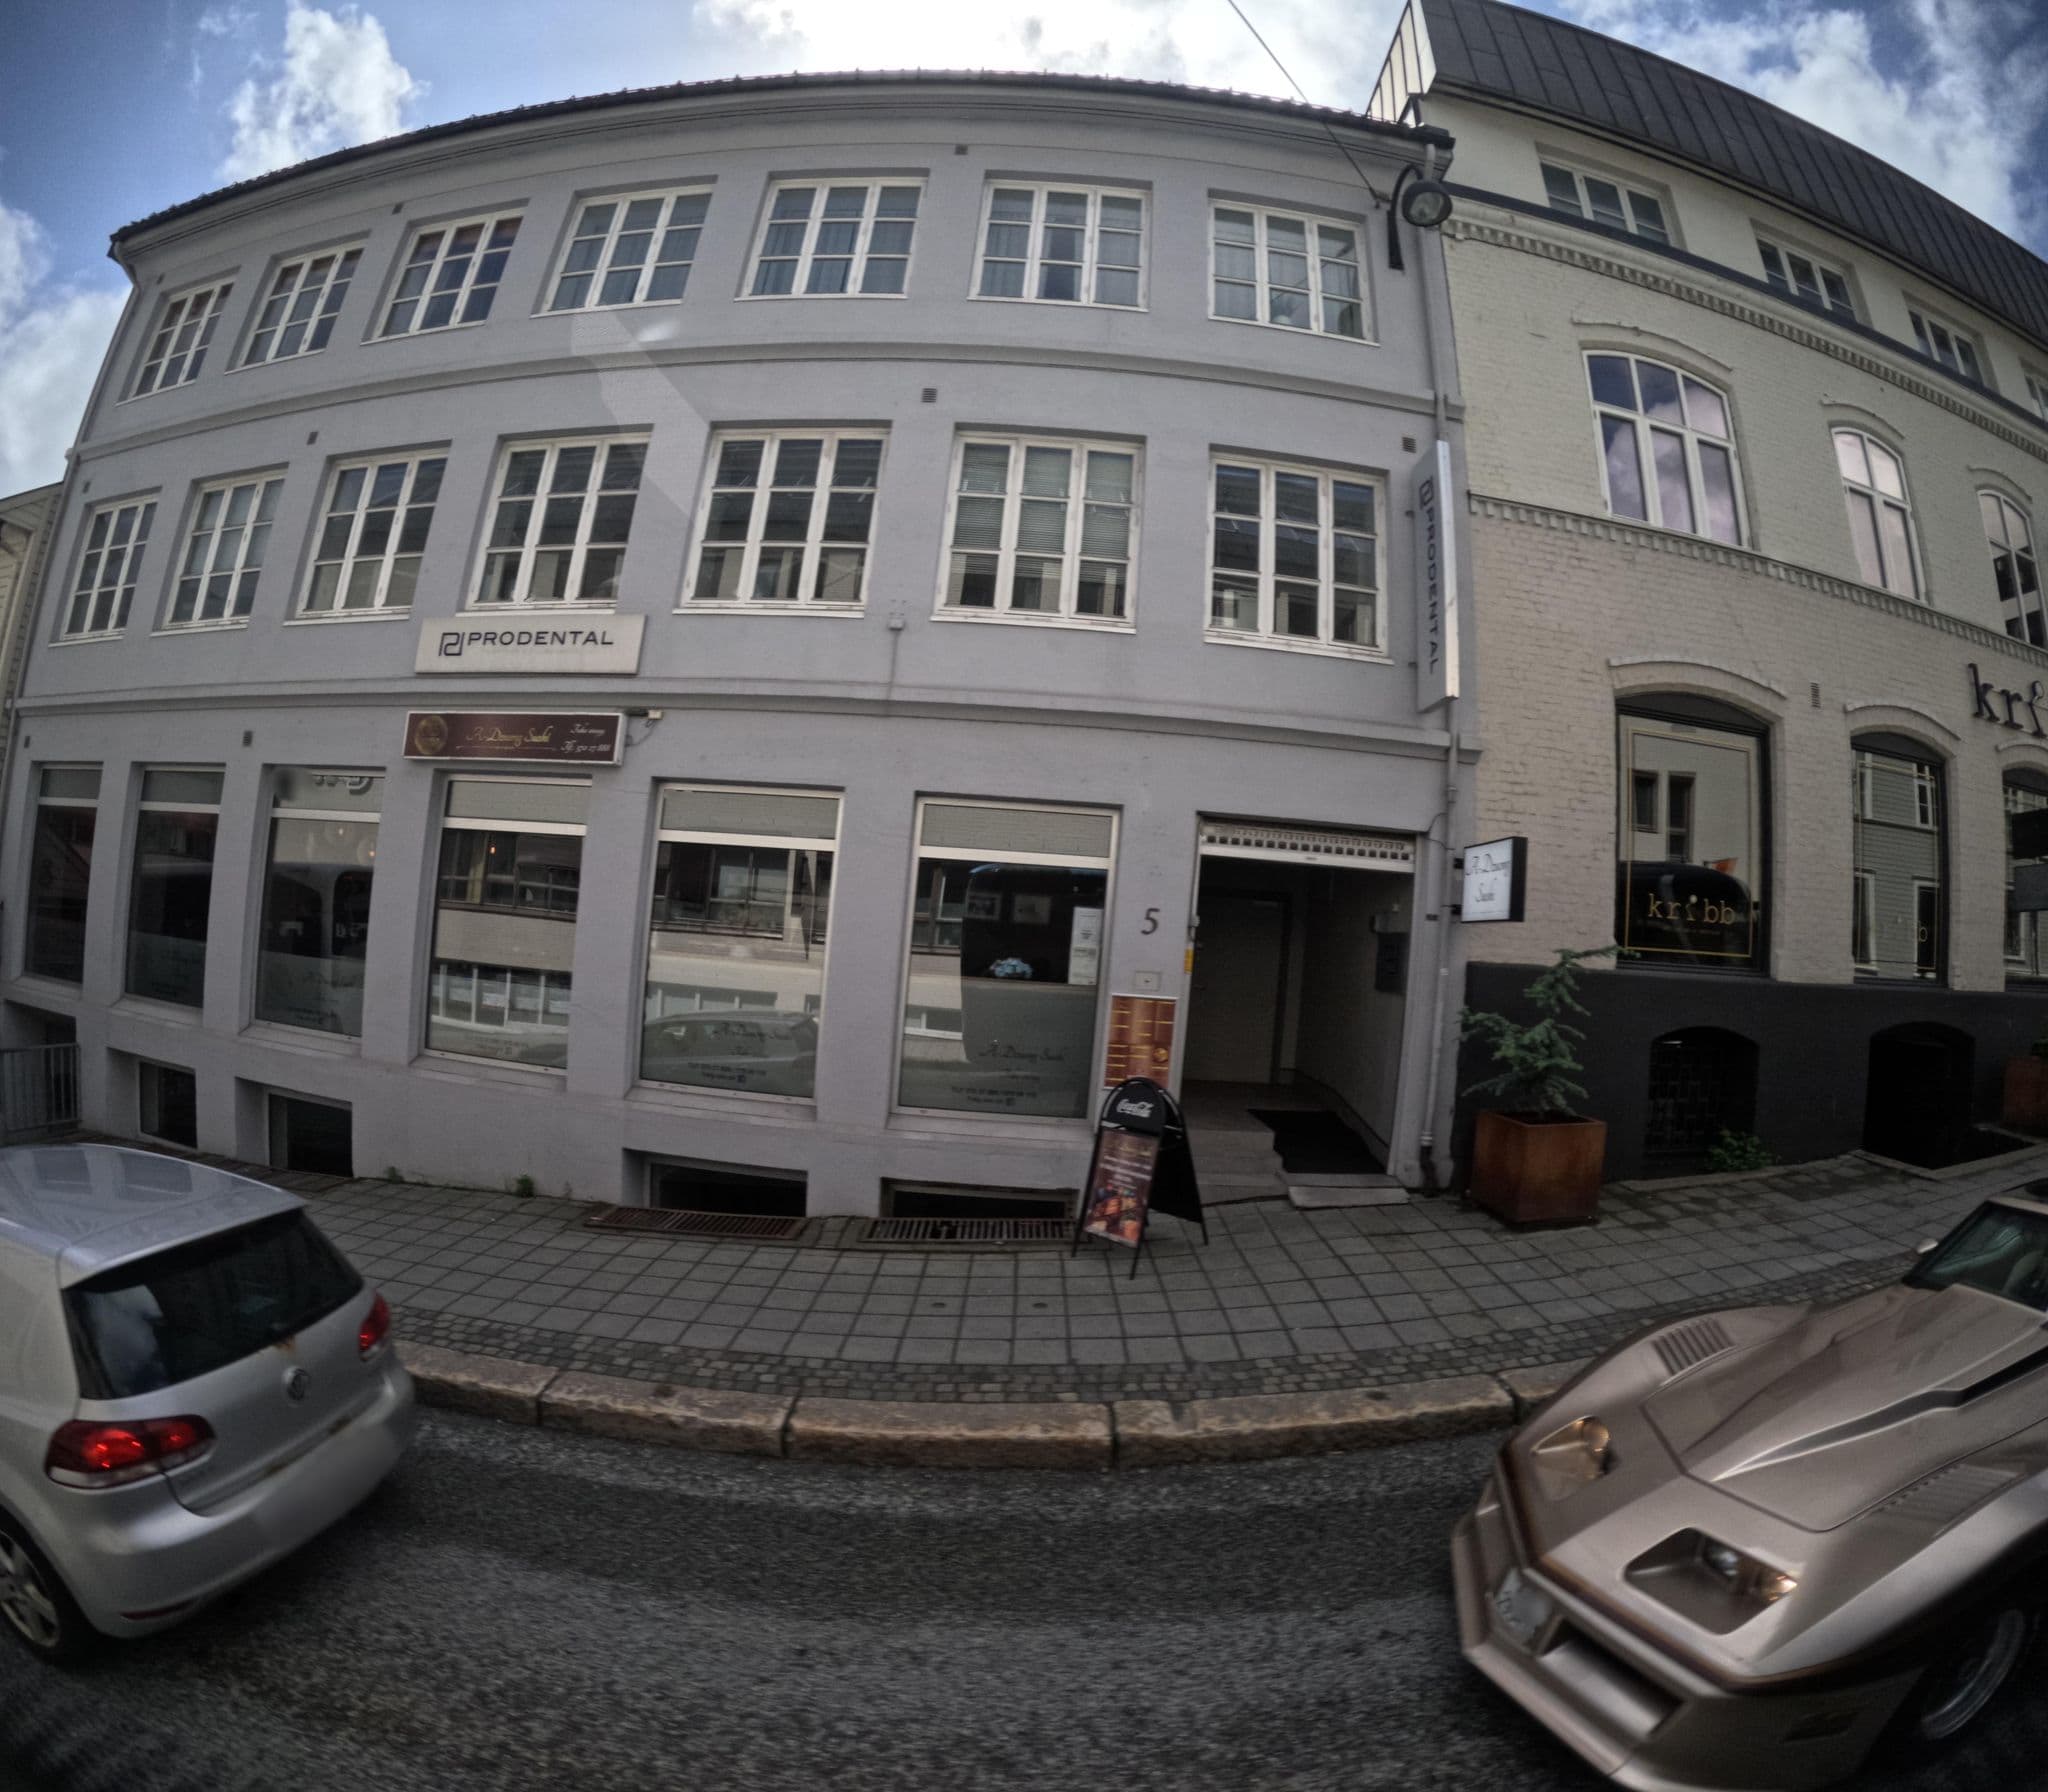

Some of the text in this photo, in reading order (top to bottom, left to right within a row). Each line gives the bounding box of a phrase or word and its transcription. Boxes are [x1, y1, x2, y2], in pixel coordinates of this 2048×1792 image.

[1426, 508, 1440, 674] PRODENTAL
[466, 630, 614, 646] PRODENTAL
[1141, 908, 1161, 935] 5
[1648, 893, 1736, 925] kribb
